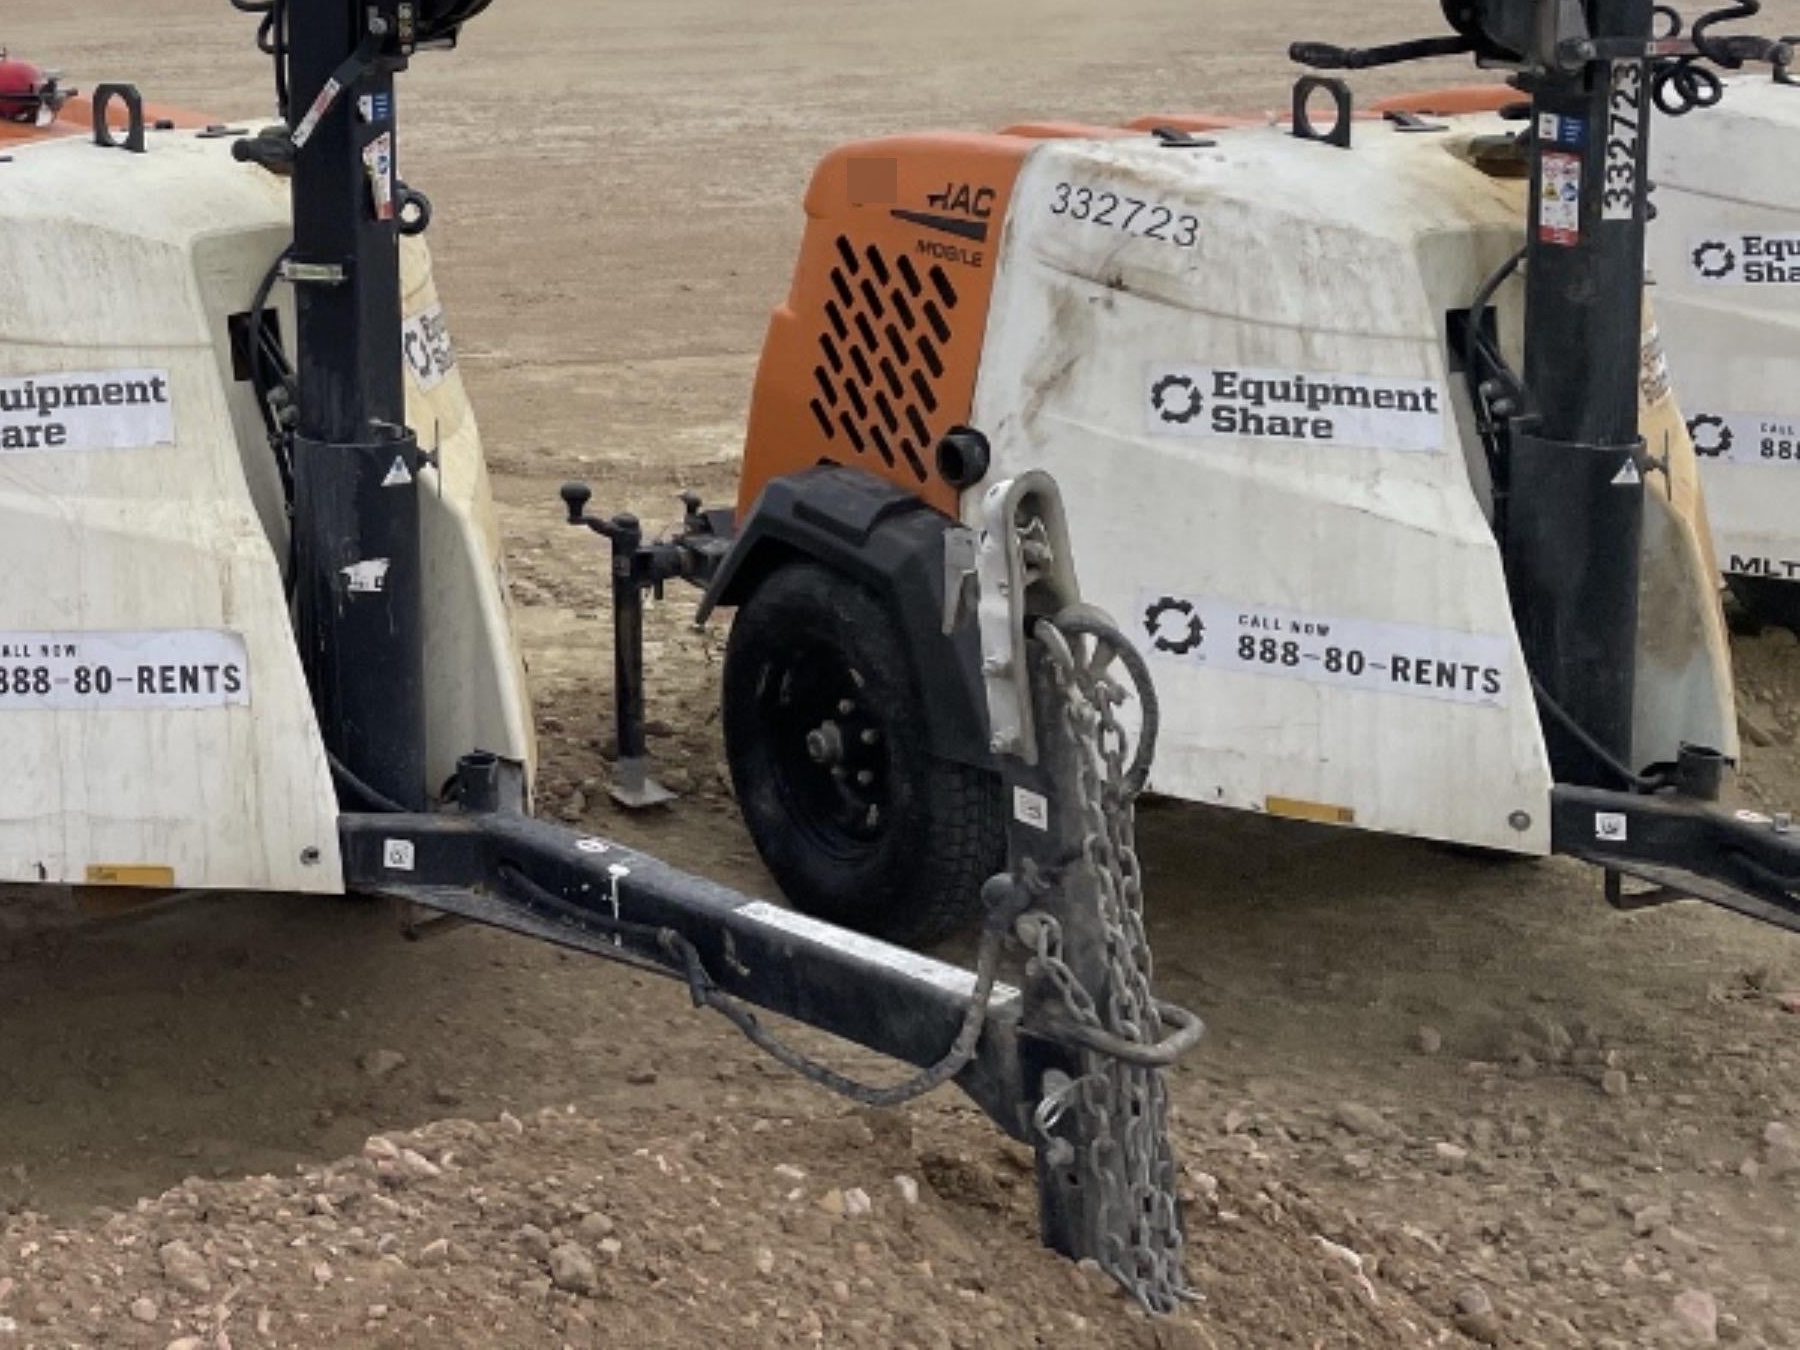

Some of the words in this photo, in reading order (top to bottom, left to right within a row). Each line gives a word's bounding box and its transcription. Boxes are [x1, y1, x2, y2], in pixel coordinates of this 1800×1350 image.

[1604, 62, 1640, 211] 332723
[1050, 182, 1199, 247] 332723
[916, 239, 984, 268] MOBILE
[1211, 370, 1439, 414] Equipment
[1211, 404, 1334, 439] Share
[1237, 614, 1282, 632] CALL
[1290, 619, 1331, 637] NOW
[41, 644, 77, 658] NOW
[1237, 634, 1502, 695] 888-80-RENTS
